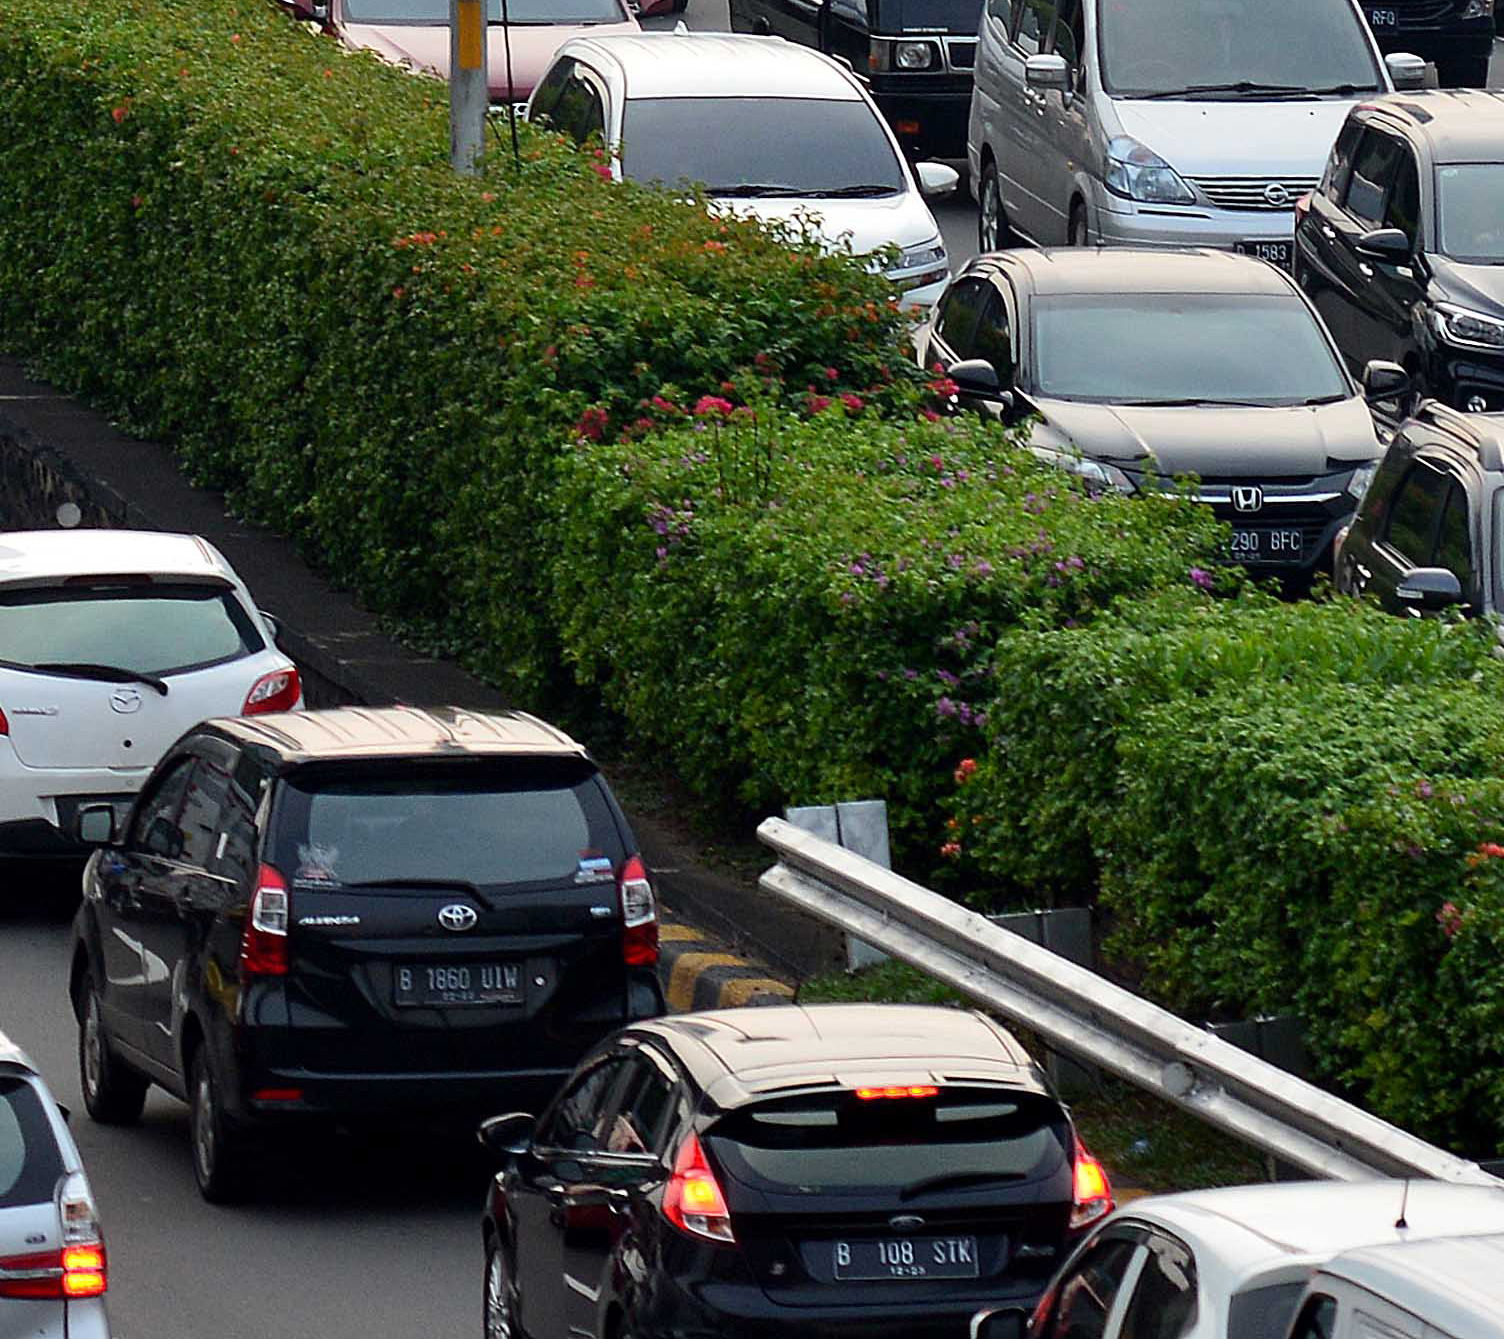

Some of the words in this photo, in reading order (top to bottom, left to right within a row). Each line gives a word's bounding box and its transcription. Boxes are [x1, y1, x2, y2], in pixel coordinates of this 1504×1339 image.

[1255, 244, 1288, 262] 1583
[1271, 530, 1300, 552] BFC
[399, 968, 412, 990] B
[426, 967, 471, 990] 1860
[480, 966, 518, 989] UIW
[837, 1242, 851, 1265] B
[879, 1241, 915, 1265] 108
[932, 1239, 973, 1264] STK
